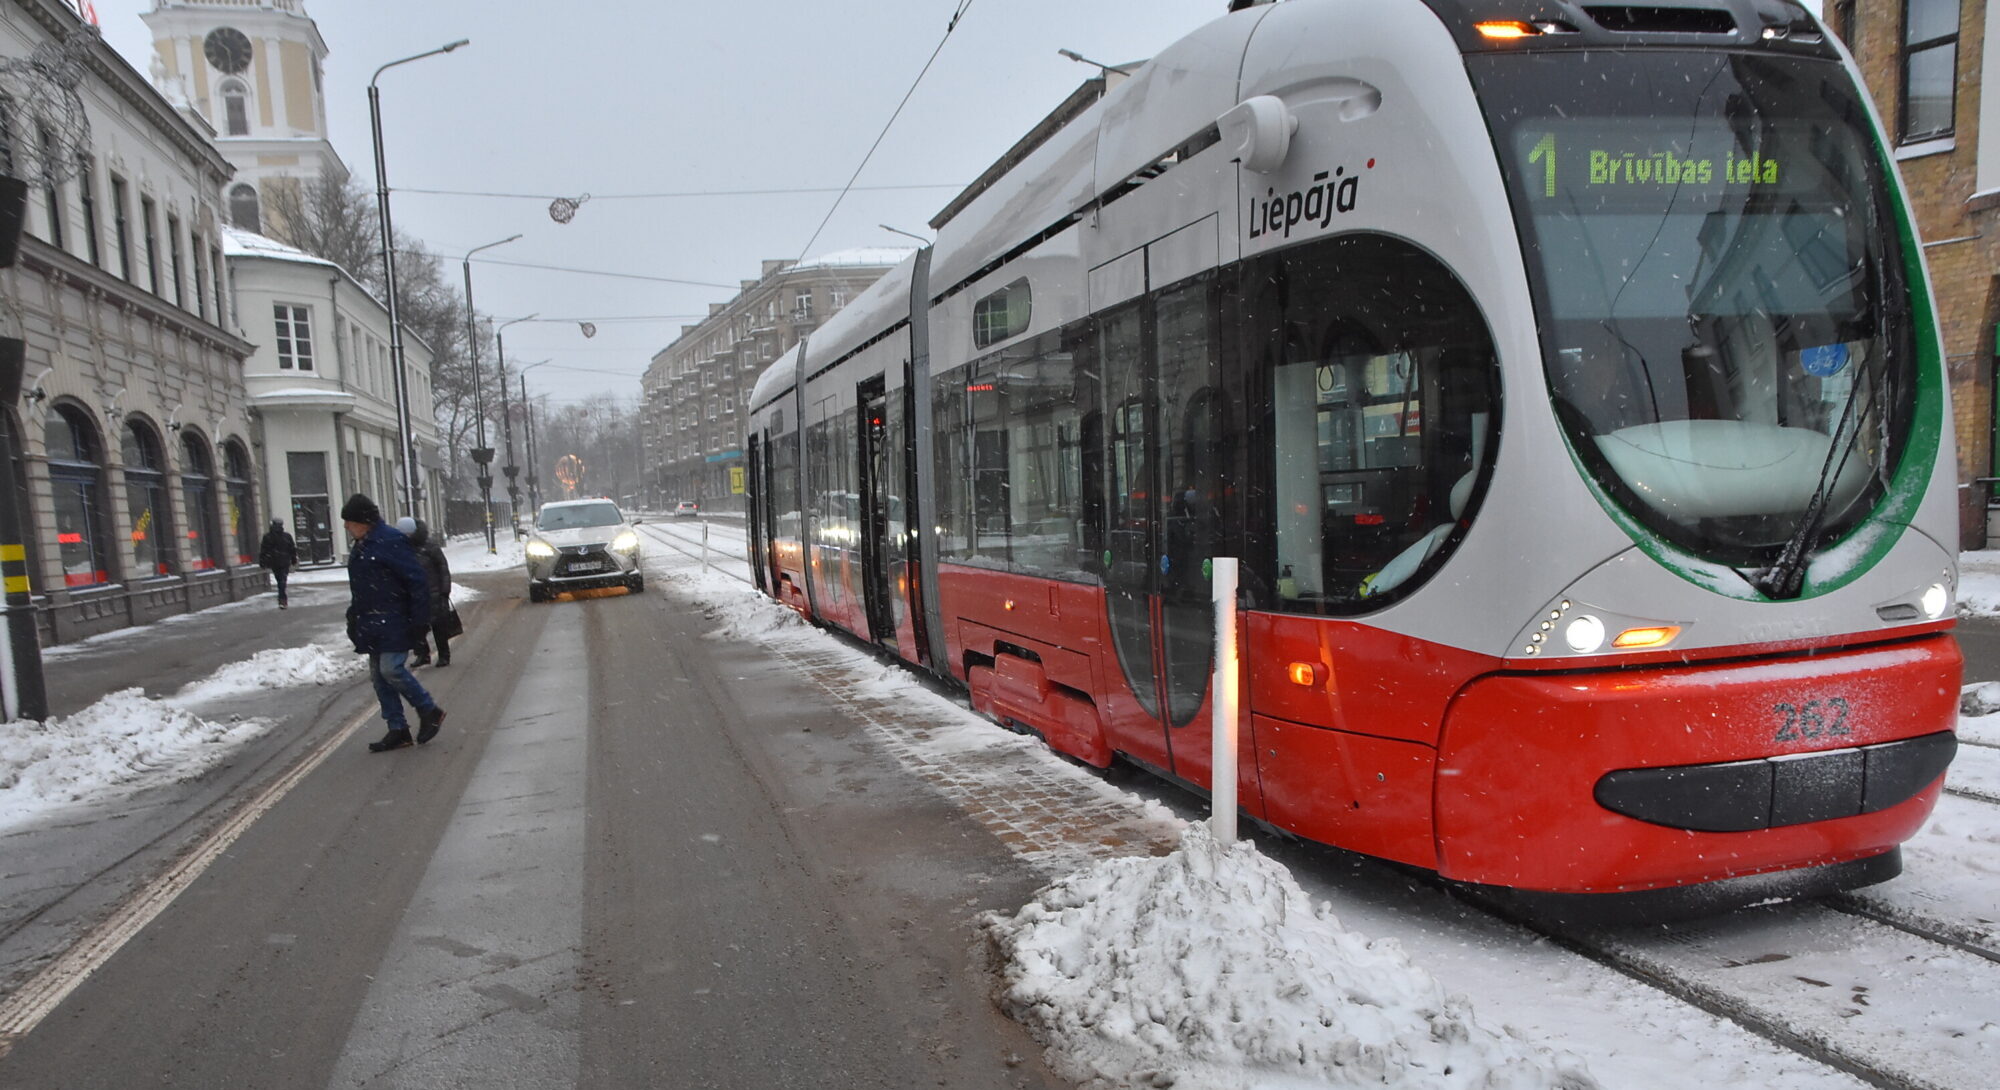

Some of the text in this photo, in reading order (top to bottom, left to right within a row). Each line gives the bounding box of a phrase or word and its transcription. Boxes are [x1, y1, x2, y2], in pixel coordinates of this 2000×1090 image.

[1528, 133, 1778, 197] 1 Brīvības iela
[1249, 166, 1359, 240] Liepāja
[1774, 698, 1851, 742] 262
